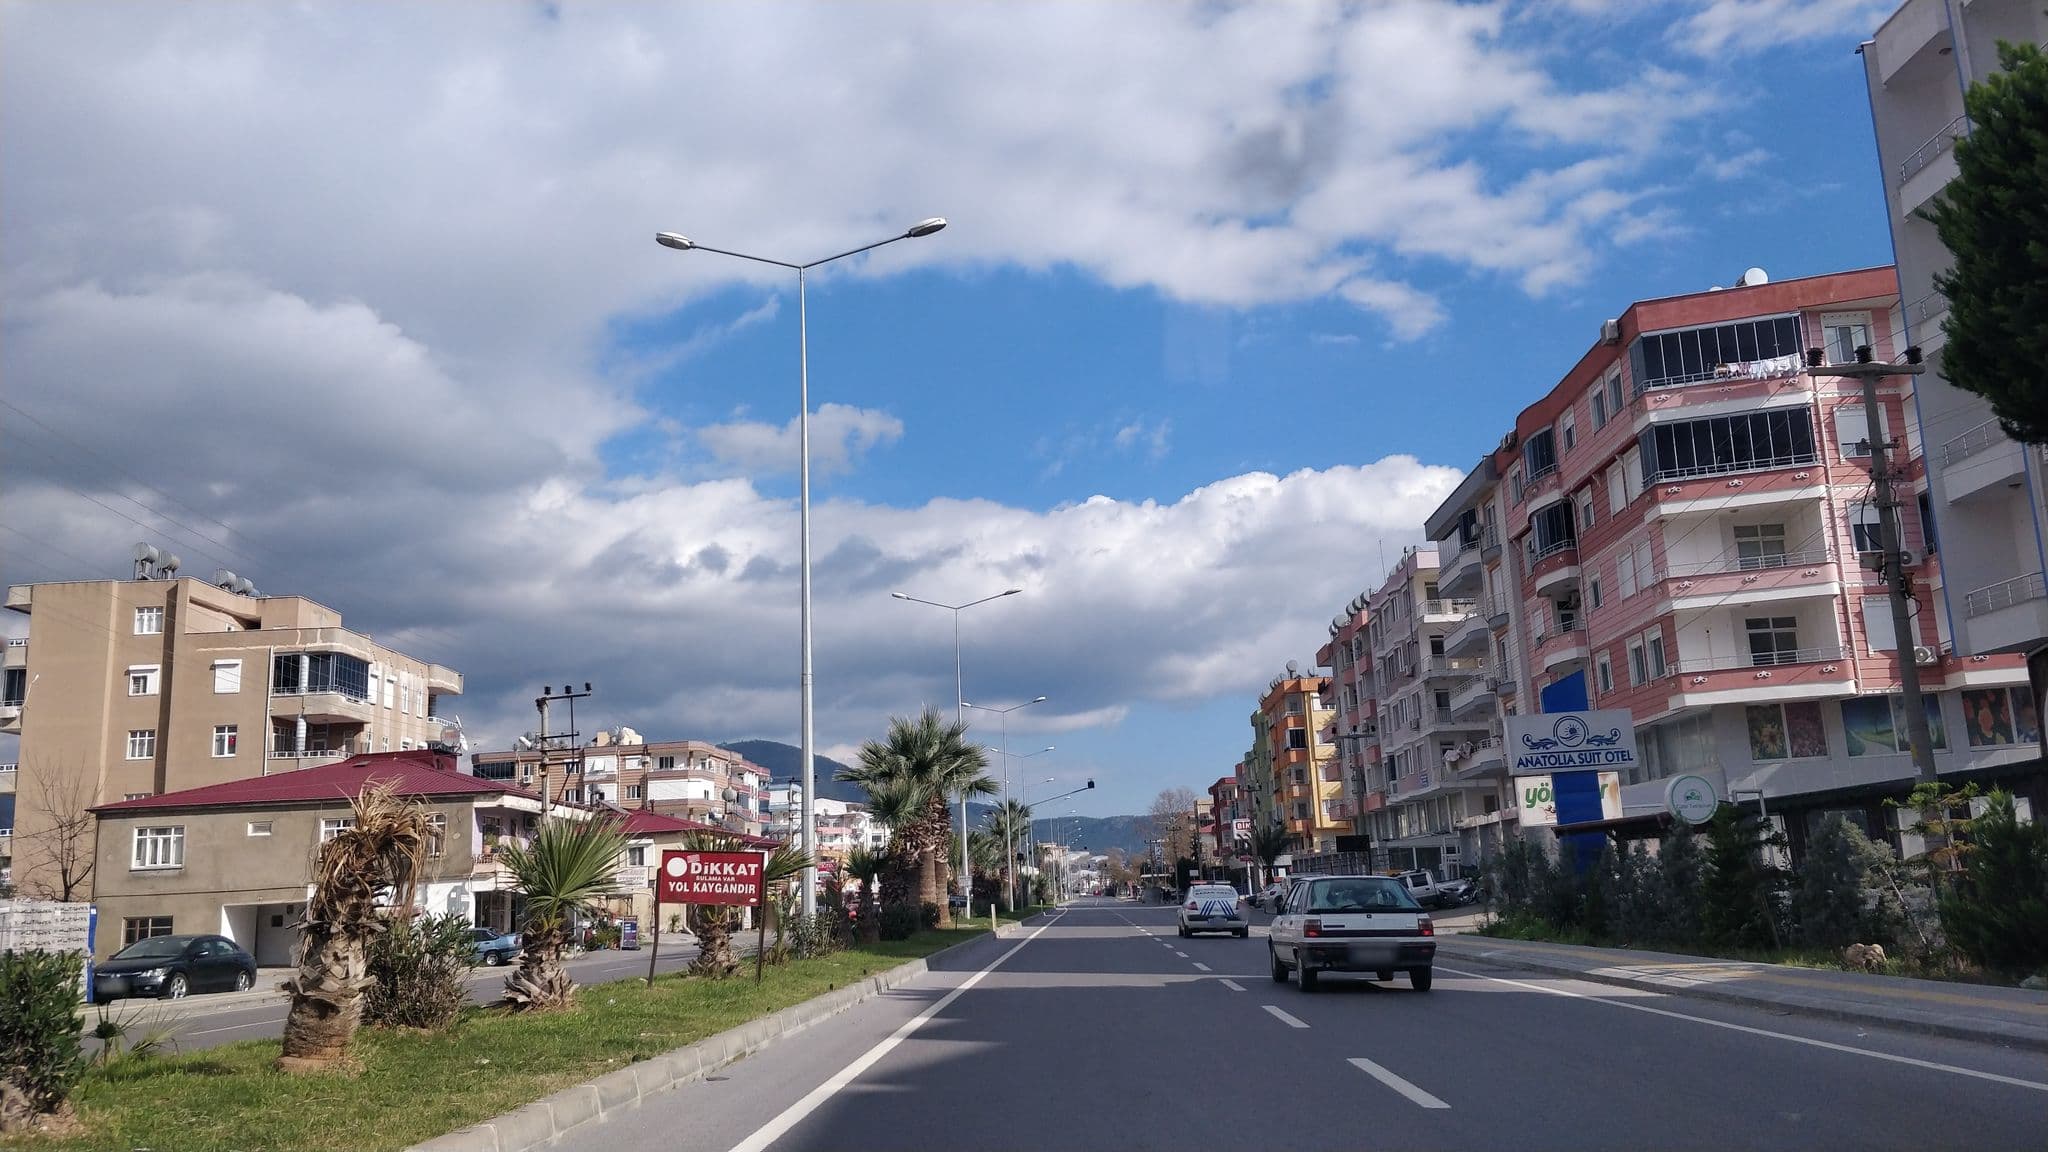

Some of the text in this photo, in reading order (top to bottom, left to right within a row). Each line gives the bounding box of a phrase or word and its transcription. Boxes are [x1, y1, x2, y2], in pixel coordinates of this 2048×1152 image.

[1517, 750, 1633, 768] ANATOLIA SUIT OTEL
[669, 881, 755, 894] YOL KAYGANDIR
